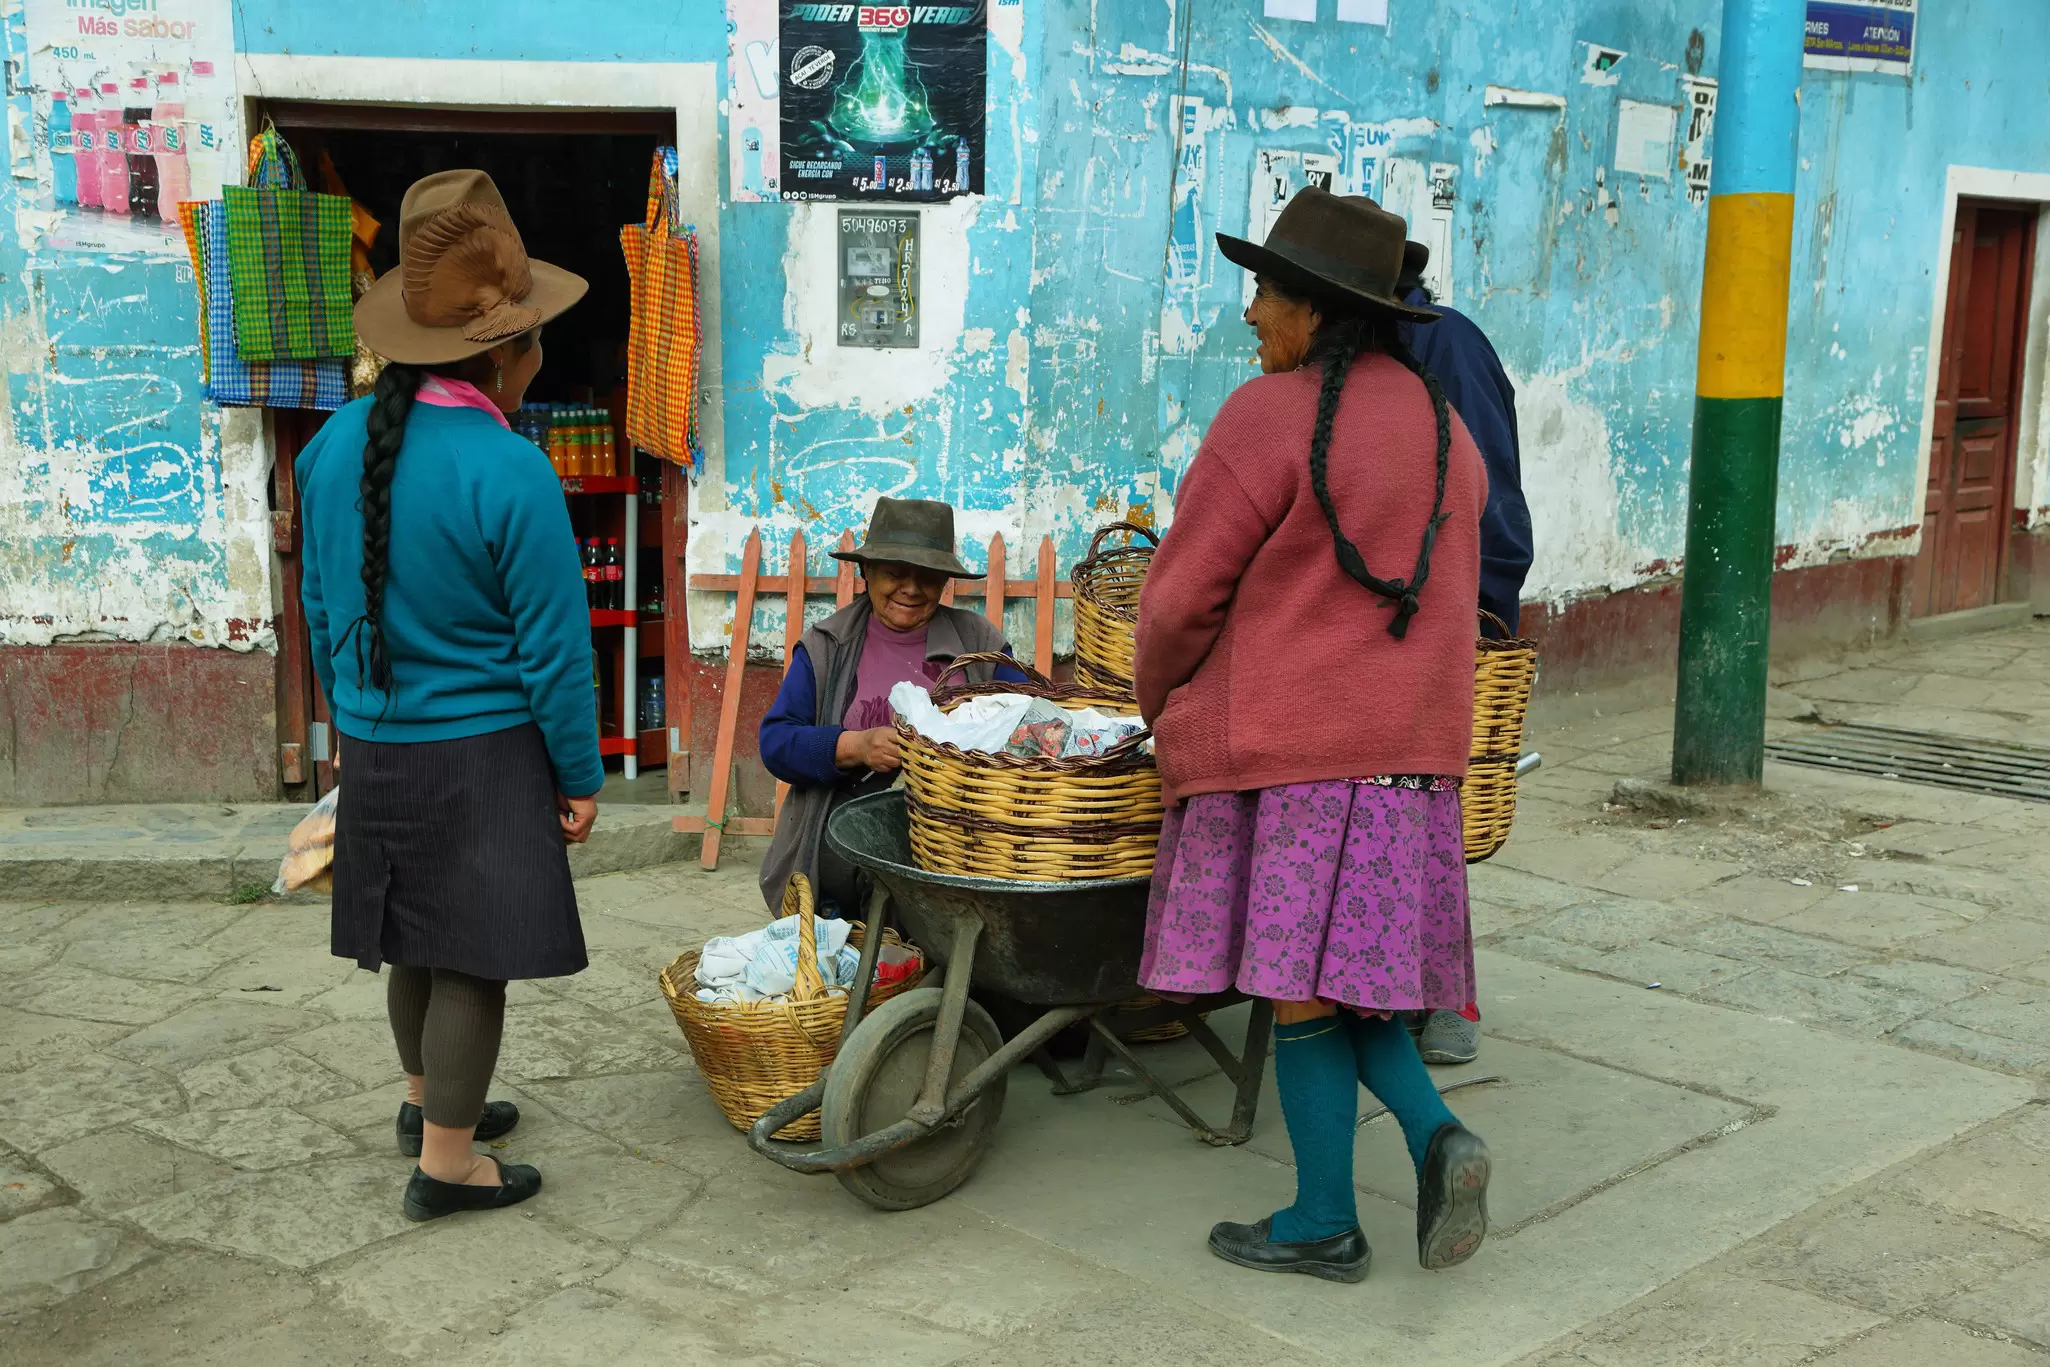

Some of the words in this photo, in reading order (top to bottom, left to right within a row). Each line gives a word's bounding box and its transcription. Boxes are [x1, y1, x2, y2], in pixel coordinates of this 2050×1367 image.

[859, 8, 909, 26] 360
[78, 16, 118, 37] Más
[123, 14, 197, 39] sabor
[52, 46, 79, 59] 450
[200, 124, 214, 148] KR
[789, 160, 806, 170] SIGUE
[806, 161, 842, 170] RECARGANDO
[819, 169, 833, 179] CON
[860, 178, 878, 192] 5.00
[895, 178, 914, 193] 2.50
[941, 179, 960, 193] 3.50
[842, 218, 907, 233] 50496093
